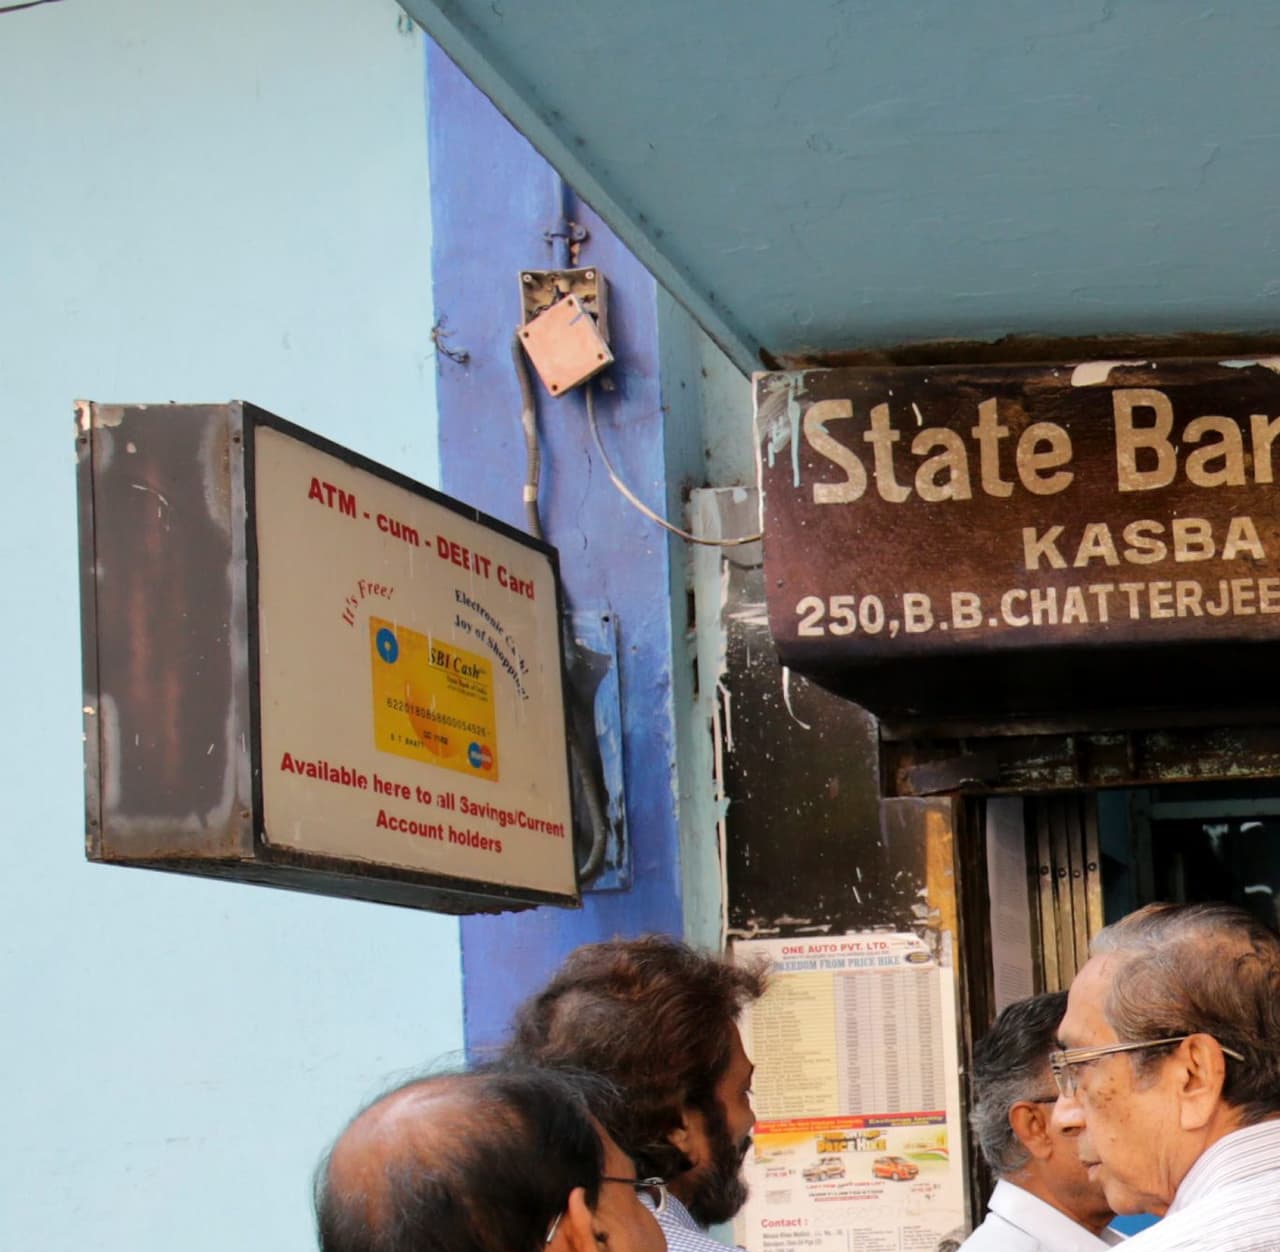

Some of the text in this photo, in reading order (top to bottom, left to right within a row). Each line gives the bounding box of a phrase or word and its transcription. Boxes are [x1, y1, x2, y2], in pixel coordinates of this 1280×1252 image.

[803, 396, 1075, 504] State
[308, 477, 357, 519] ATM
[376, 513, 420, 547] cum
[497, 564, 535, 600] Card
[1022, 516, 1265, 570] KASBA
[358, 578, 395, 600] Free!
[455, 588, 503, 635] Electronic
[475, 626, 486, 642] of
[429, 647, 481, 680] SBI Cash
[280, 751, 565, 839] Available here to all Savings/Current
[376, 809, 503, 853] Account holders
[782, 946, 804, 954] ONE
[808, 944, 837, 953] AUTO
[867, 942, 889, 950] LTD.
[761, 1219, 802, 1228] Contact
